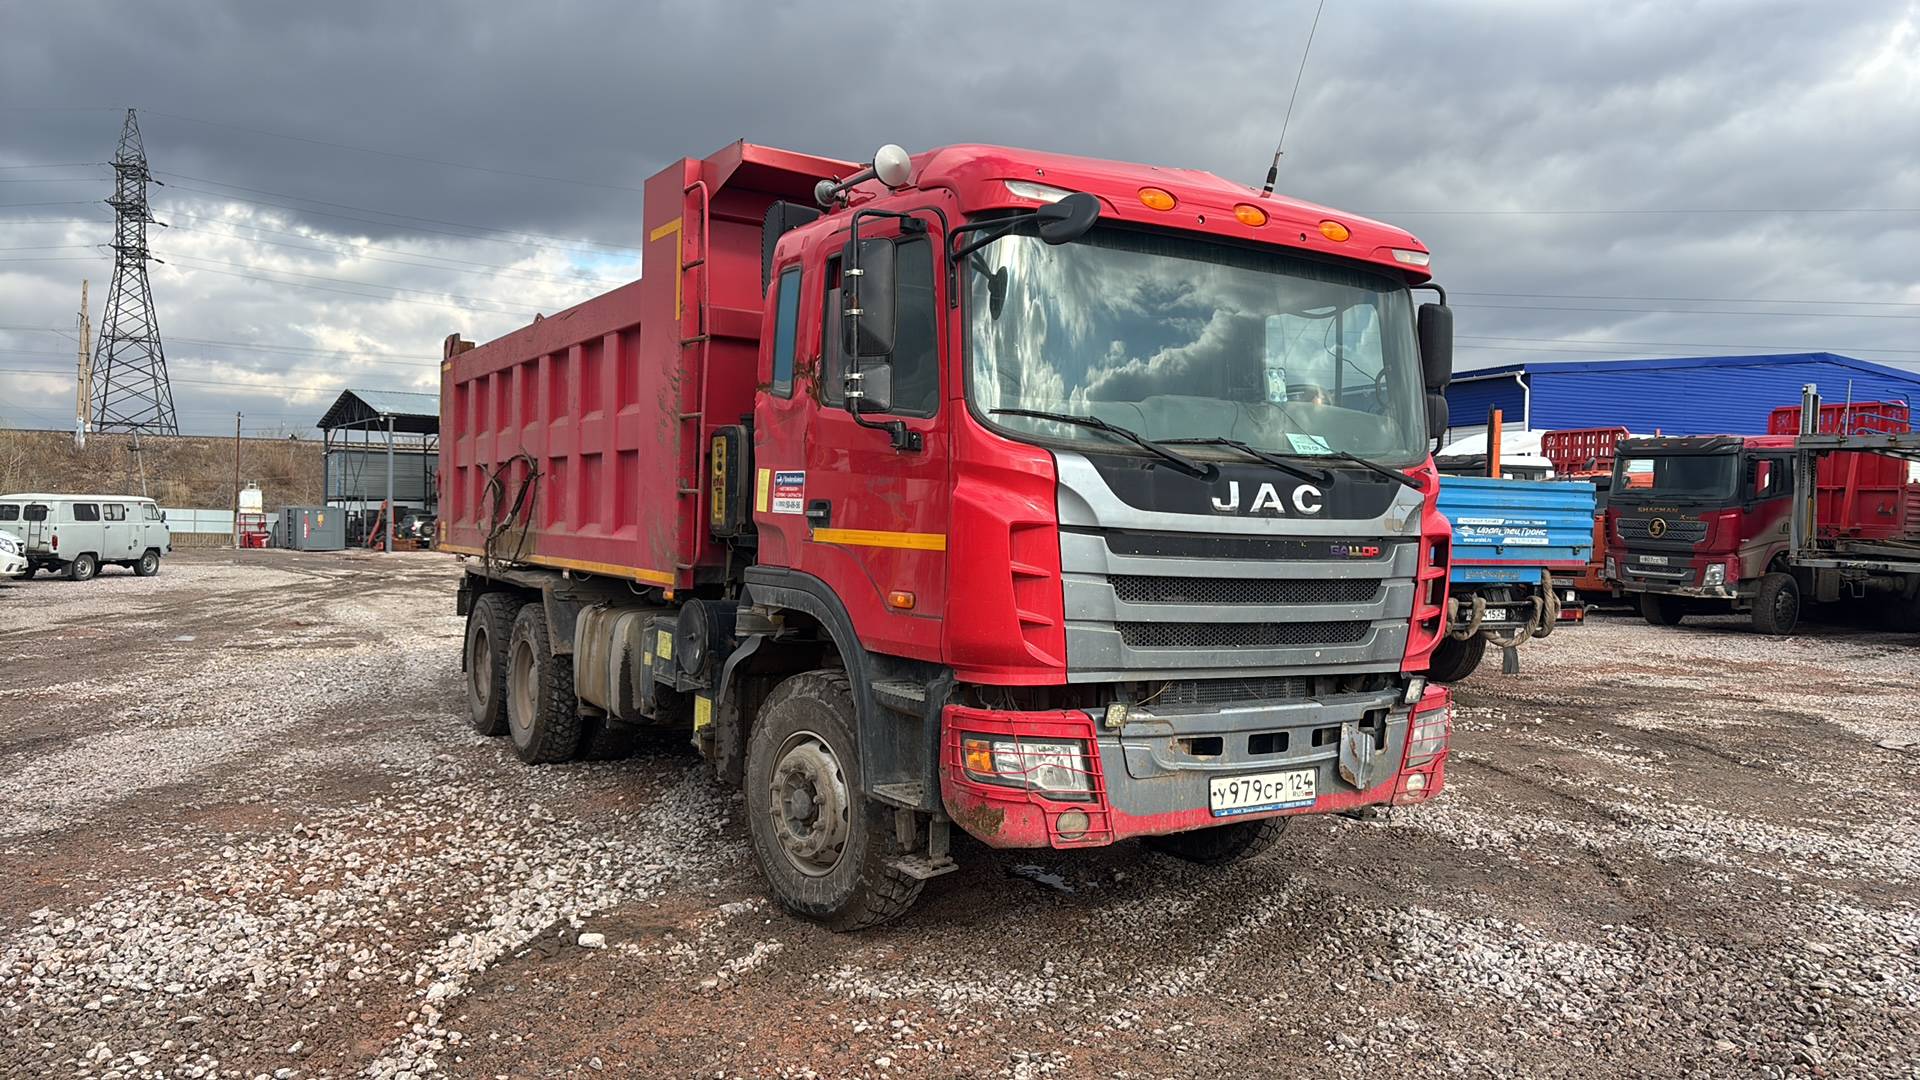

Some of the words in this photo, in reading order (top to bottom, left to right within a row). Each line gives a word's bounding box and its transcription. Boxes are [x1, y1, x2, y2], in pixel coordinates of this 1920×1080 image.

[1211, 480, 1323, 515] JAC
[1330, 545, 1380, 557] GALLOP
[1218, 779, 1284, 805] У979СР
[1288, 772, 1312, 791] 124
